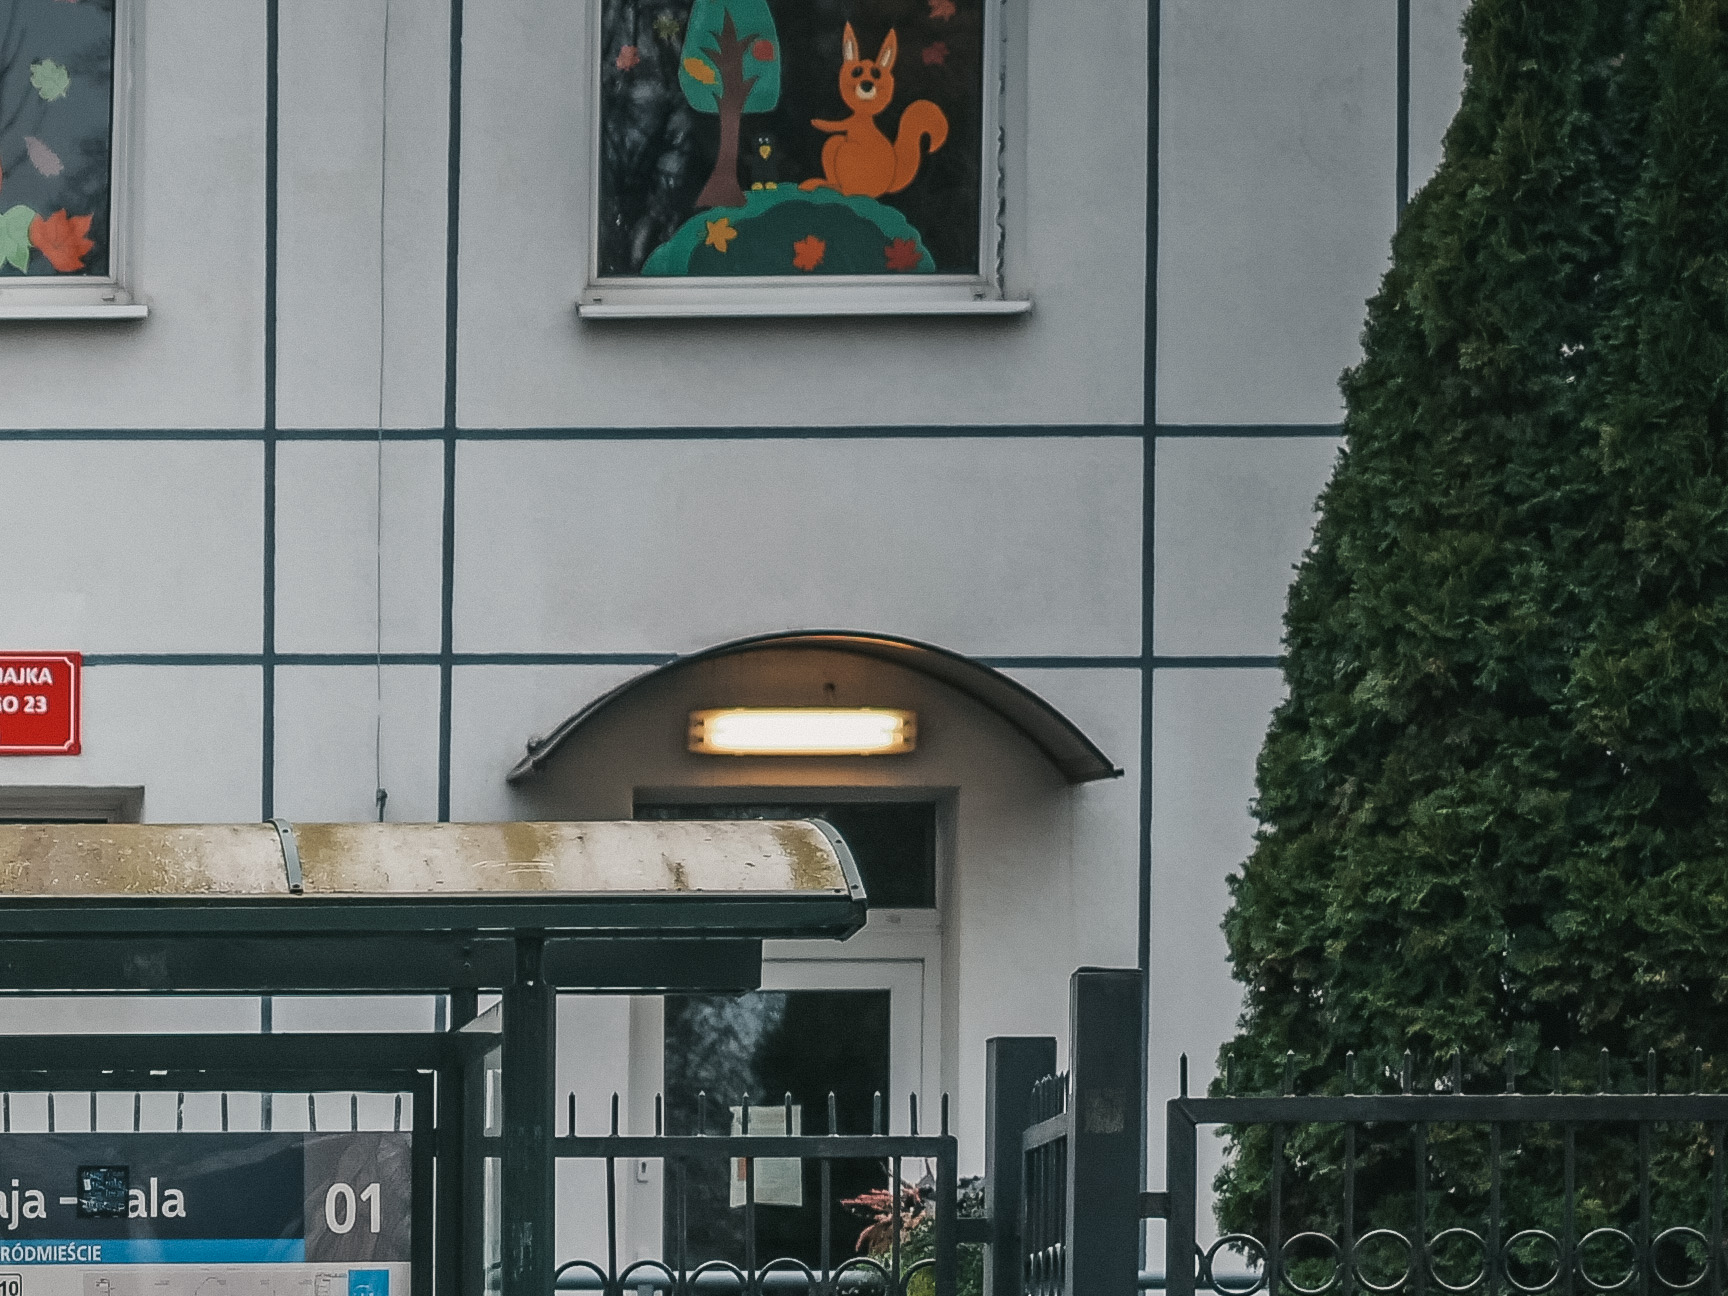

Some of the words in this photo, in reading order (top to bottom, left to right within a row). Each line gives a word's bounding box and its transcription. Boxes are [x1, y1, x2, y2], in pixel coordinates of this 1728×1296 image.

[23, 695, 47, 713] 23
[127, 1177, 186, 1219] ala
[325, 1182, 381, 1234] 01
